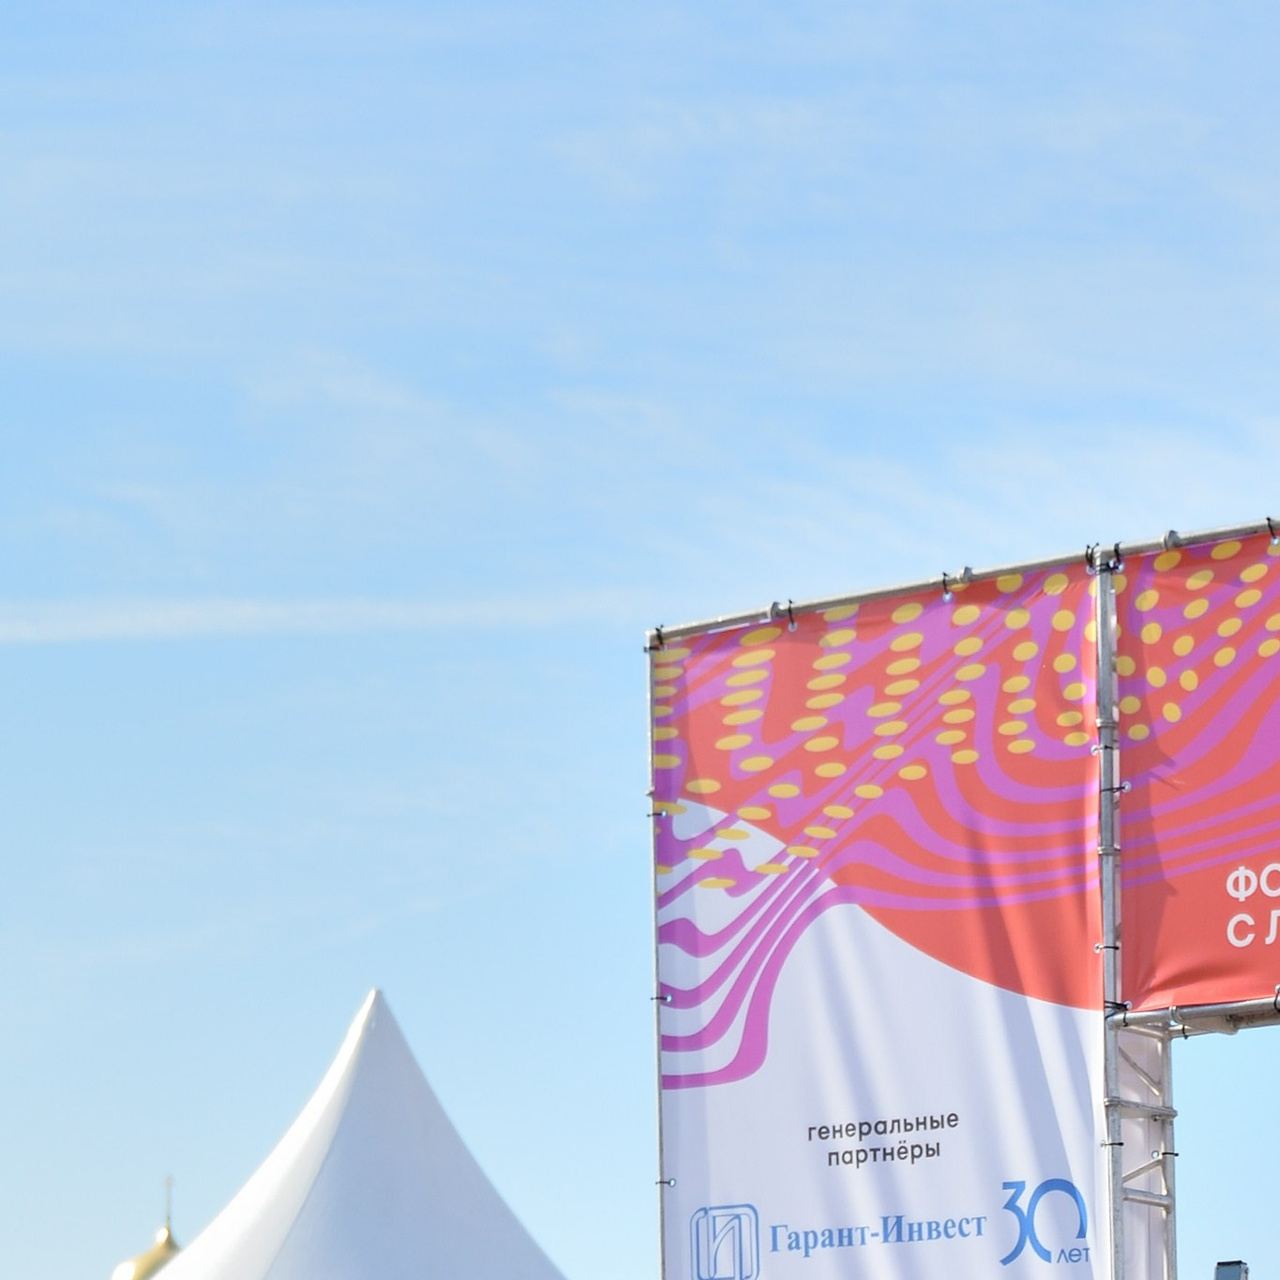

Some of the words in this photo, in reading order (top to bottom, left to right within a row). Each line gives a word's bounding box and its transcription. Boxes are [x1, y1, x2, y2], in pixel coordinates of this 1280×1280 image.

[1226, 913, 1255, 948] С
[807, 1110, 959, 1144] генеральные
[827, 1139, 941, 1169] партнёры
[769, 1214, 987, 1258] Гарант-Инвест
[1000, 1178, 1088, 1266] 30
[1056, 1246, 1091, 1264] лет
